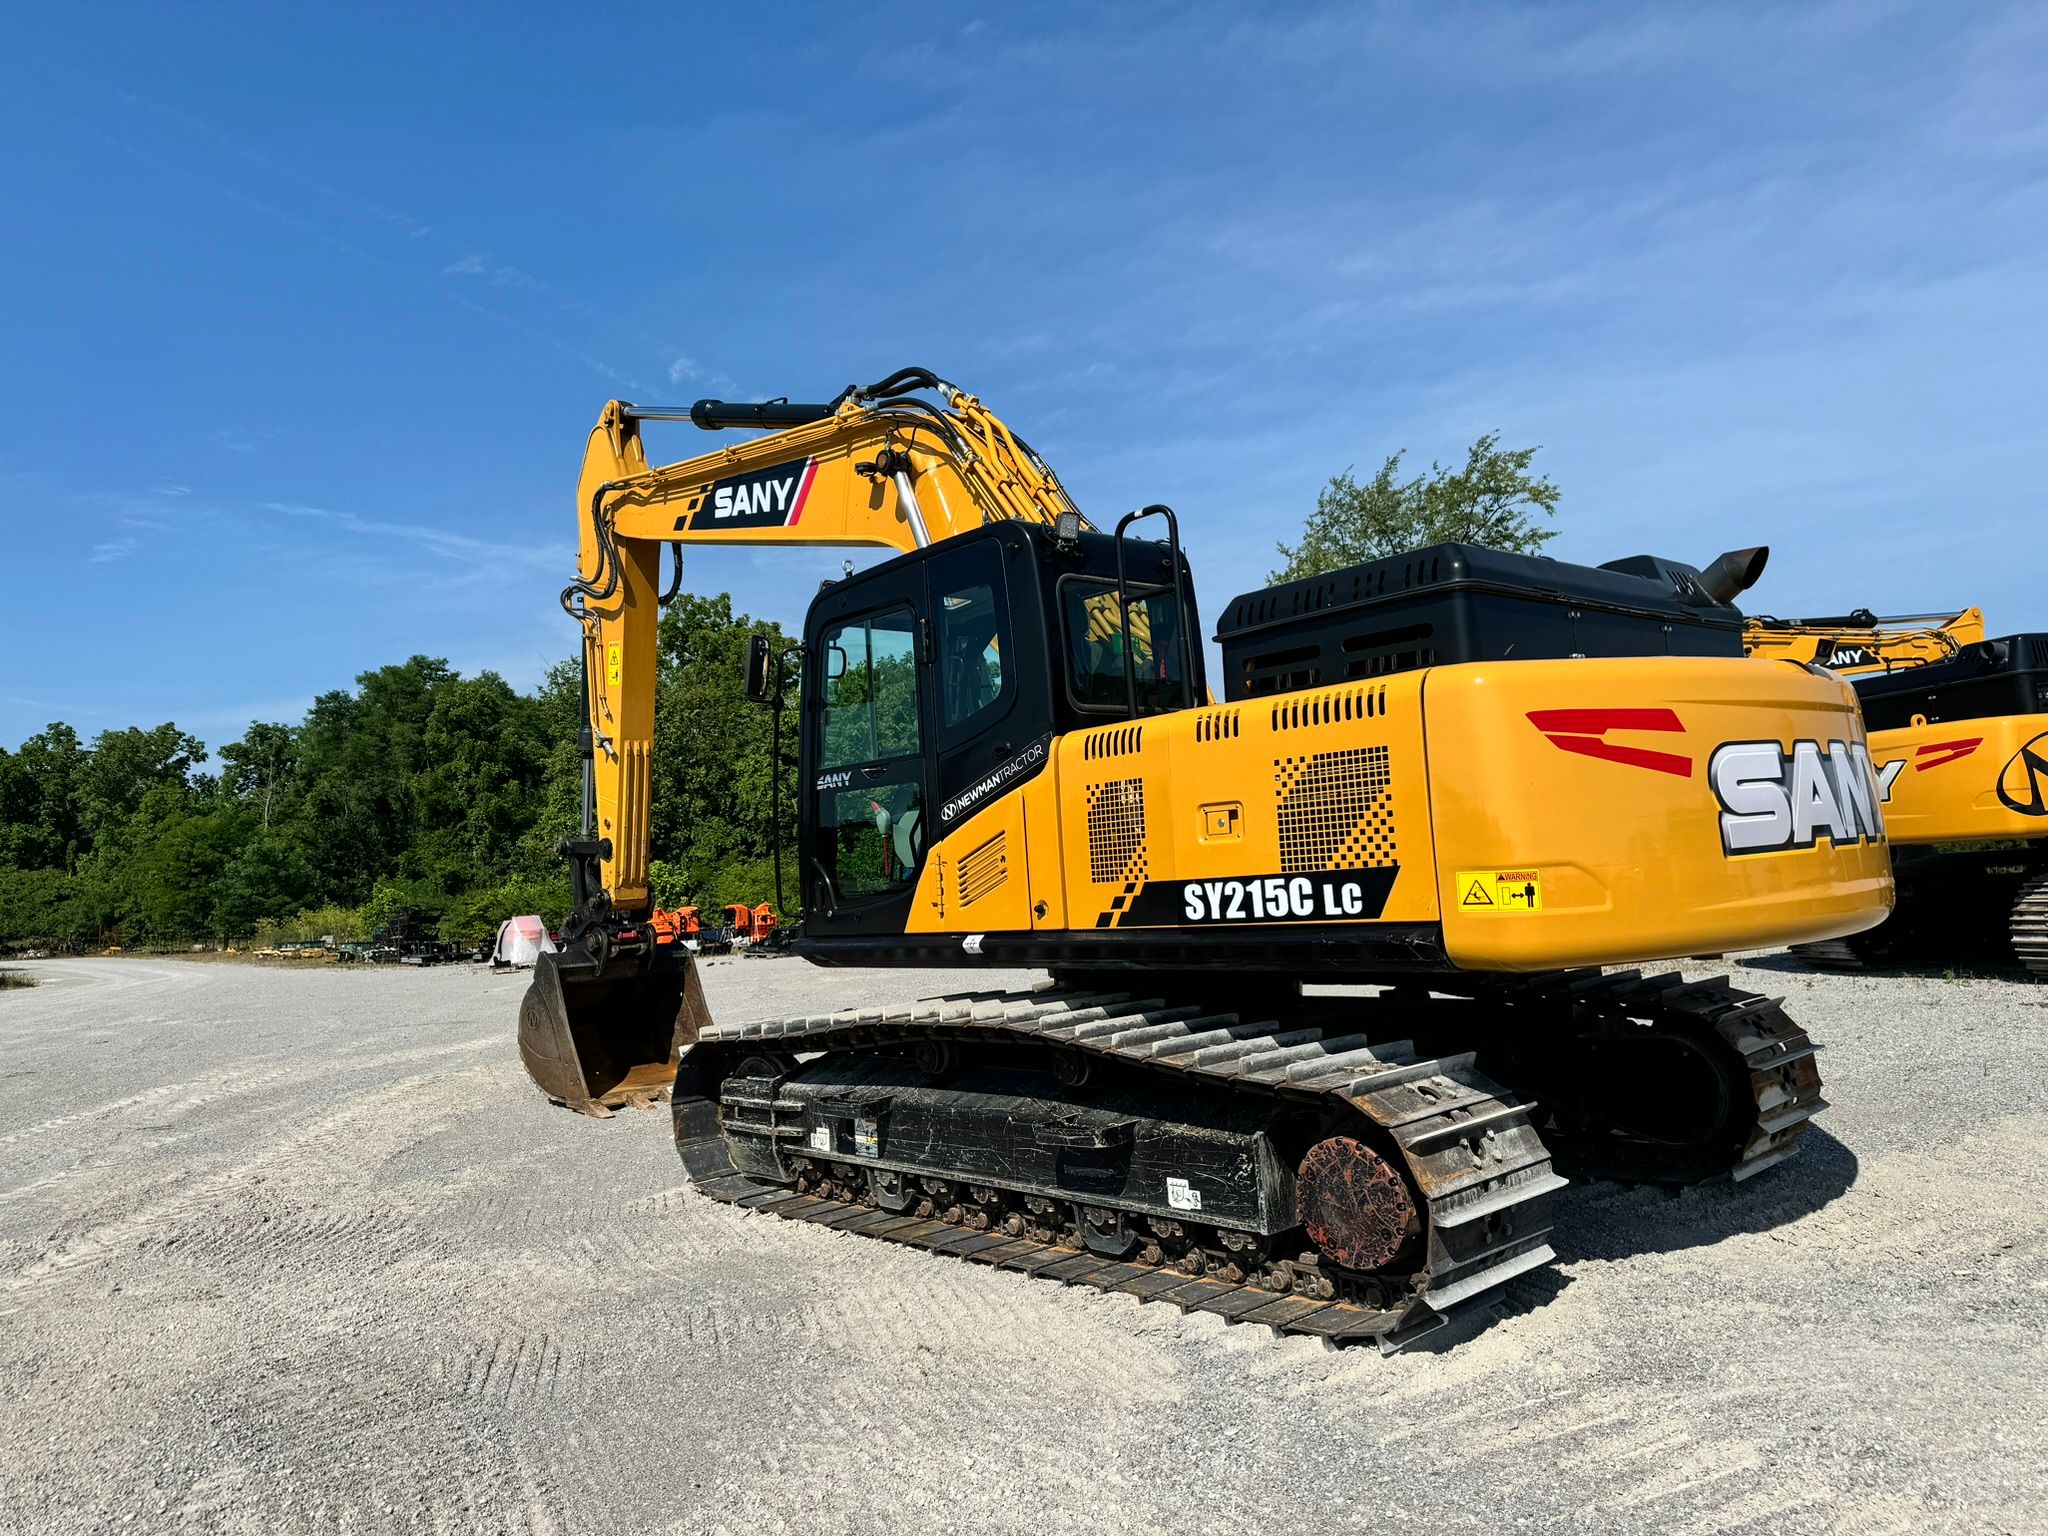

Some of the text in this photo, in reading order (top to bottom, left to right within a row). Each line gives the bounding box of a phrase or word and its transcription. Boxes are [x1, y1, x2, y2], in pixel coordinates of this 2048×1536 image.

[714, 477, 794, 519] SANY
[1824, 649, 1863, 666] ANY
[816, 770, 853, 790] SANY
[1708, 739, 1883, 855] SAN
[1504, 871, 1537, 881] WARNING
[1183, 877, 1363, 921] SY215C LC
